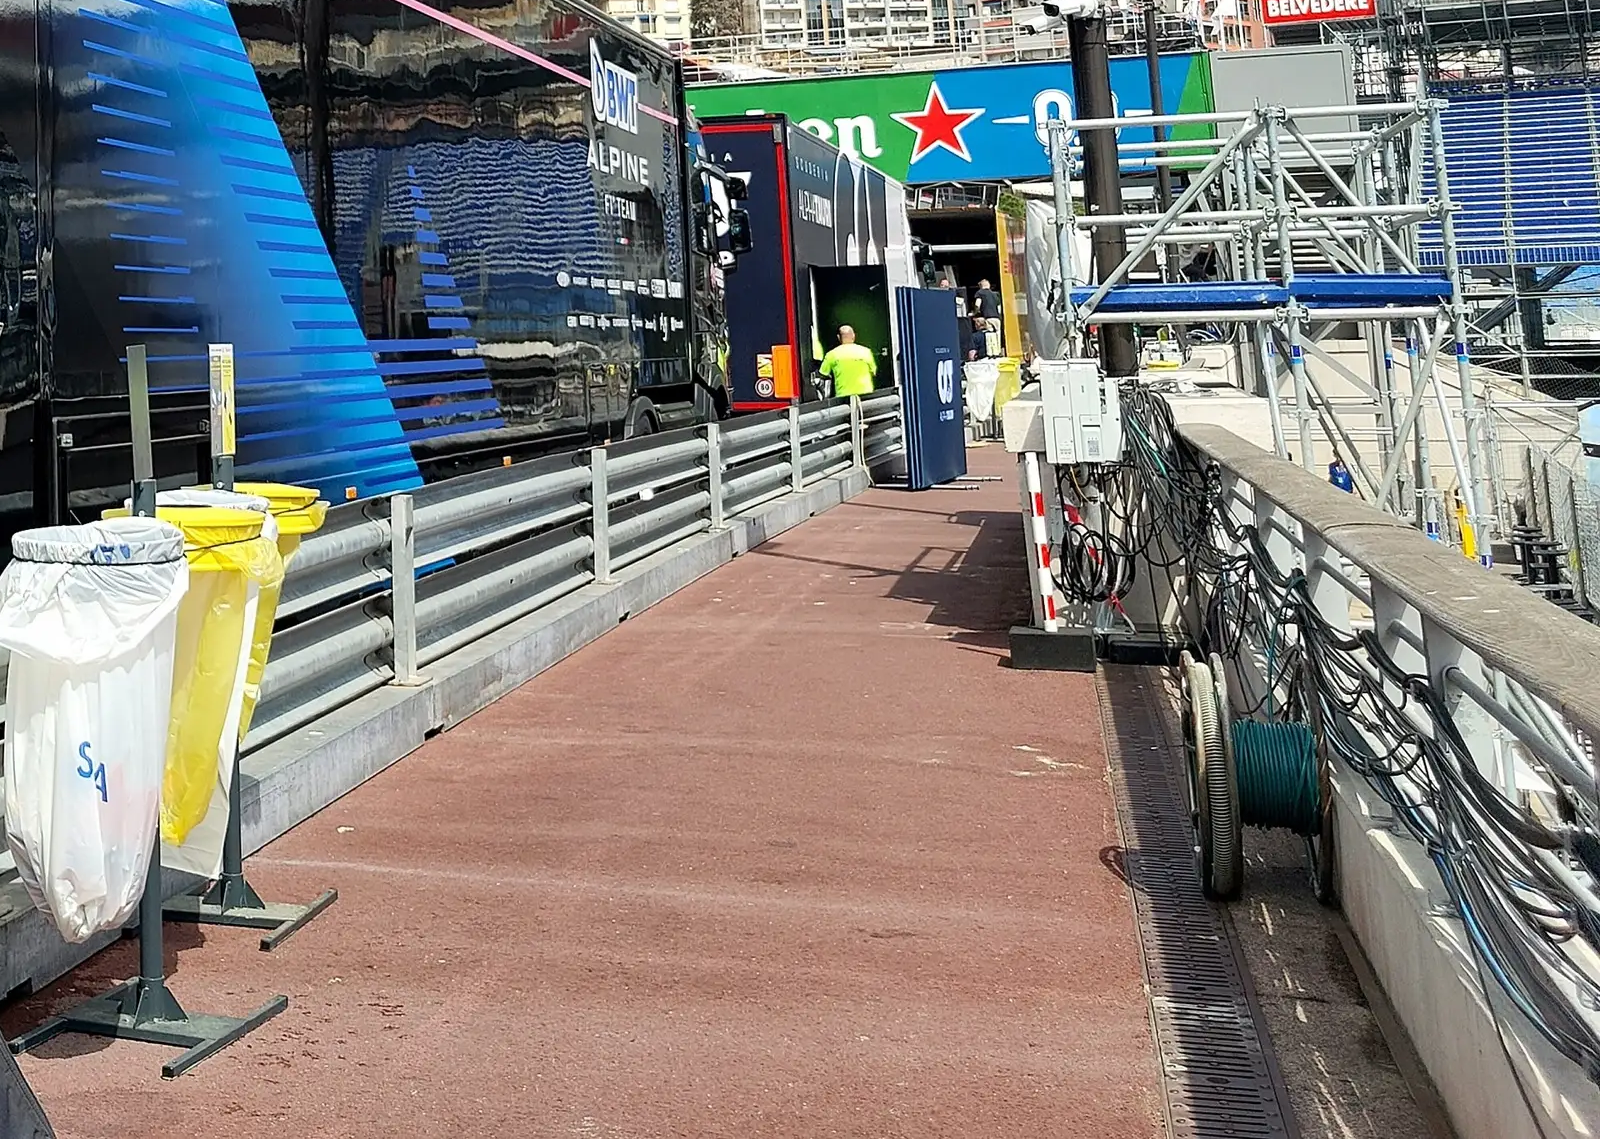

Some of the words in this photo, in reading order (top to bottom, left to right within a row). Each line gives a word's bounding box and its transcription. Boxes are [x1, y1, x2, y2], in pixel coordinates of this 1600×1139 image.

[604, 61, 638, 135] BWT
[586, 138, 649, 187] ALPINE
[615, 196, 637, 222] TEAM
